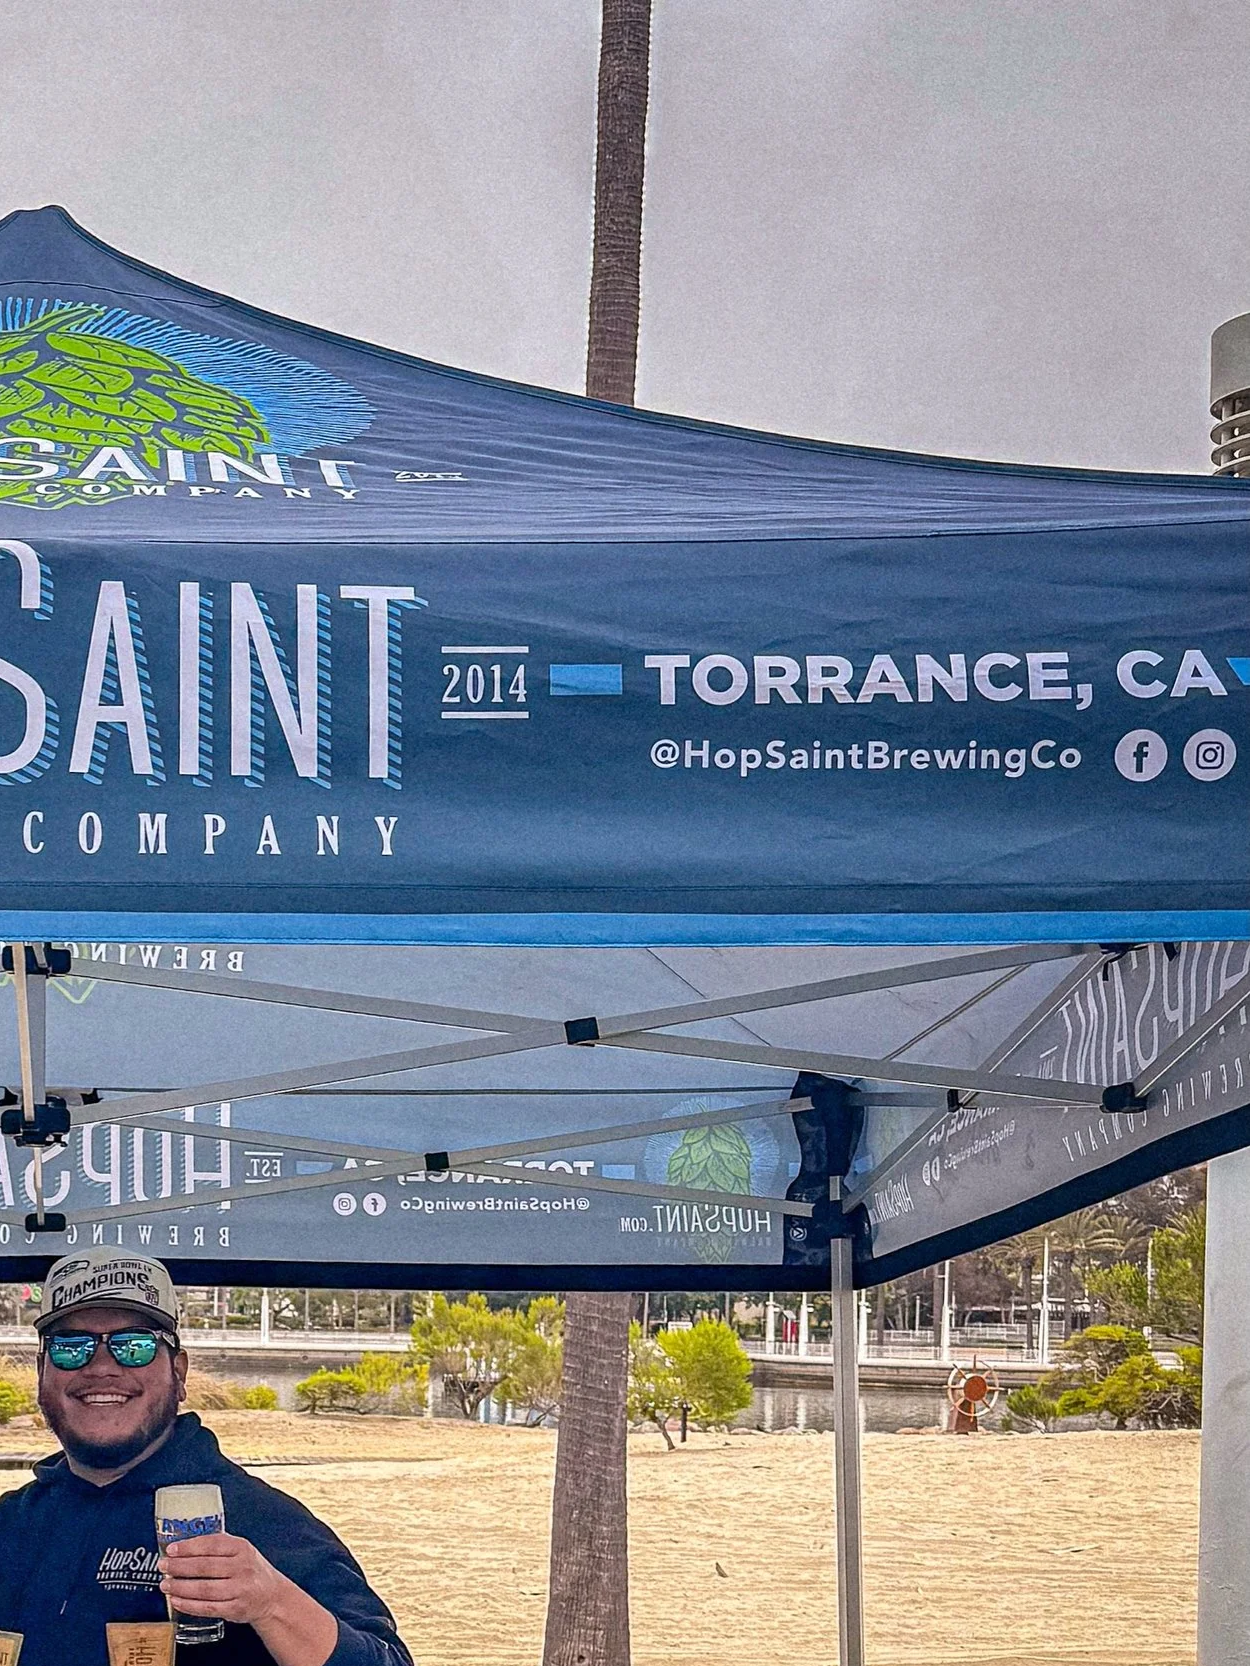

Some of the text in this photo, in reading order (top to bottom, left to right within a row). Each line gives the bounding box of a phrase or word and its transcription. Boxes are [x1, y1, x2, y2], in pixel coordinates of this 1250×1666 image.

[36, 483, 360, 499] COMPANY
[442, 663, 528, 704] 2014
[644, 648, 1227, 711] TORRANCE, CA
[650, 738, 1082, 778] @HopSaintBrewingCo
[23, 812, 400, 858] COMPANY
[52, 1271, 149, 1310] CHAMPIONS
